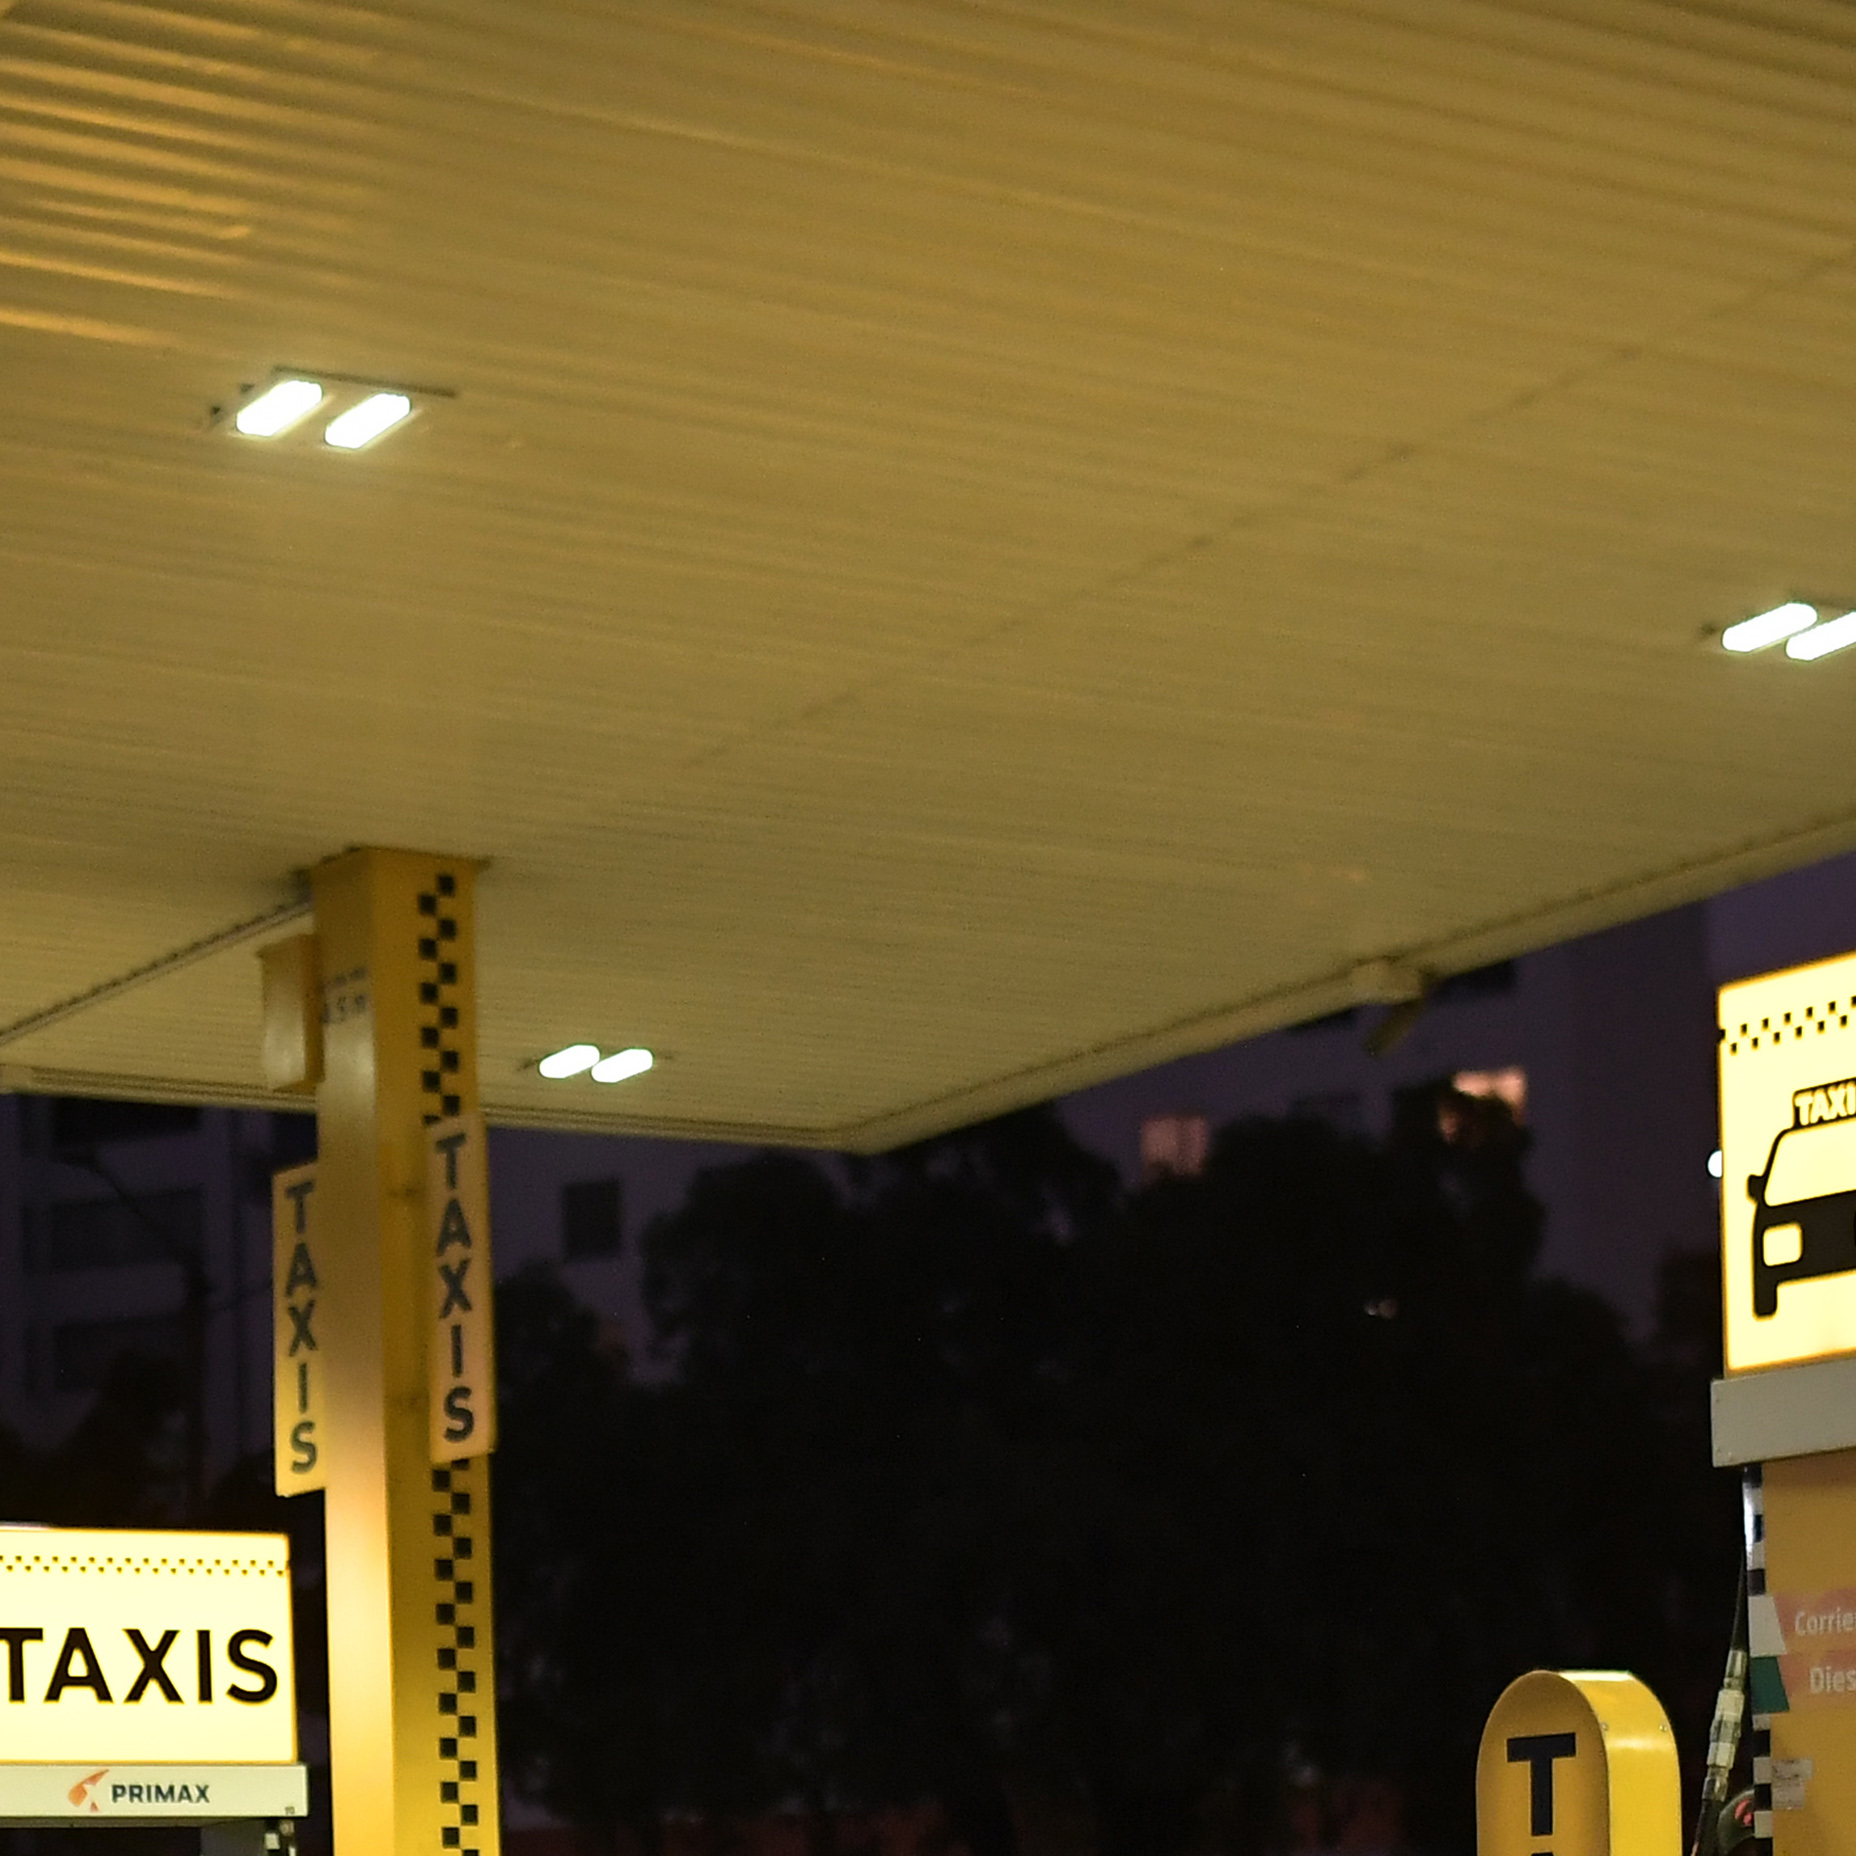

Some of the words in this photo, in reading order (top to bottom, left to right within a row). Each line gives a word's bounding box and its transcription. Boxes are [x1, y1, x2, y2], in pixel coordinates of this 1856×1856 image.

[286, 1180, 318, 1474] TAXIS
[436, 1134, 475, 1442] TAXIS
[112, 1784, 211, 1804] PRIMAX
